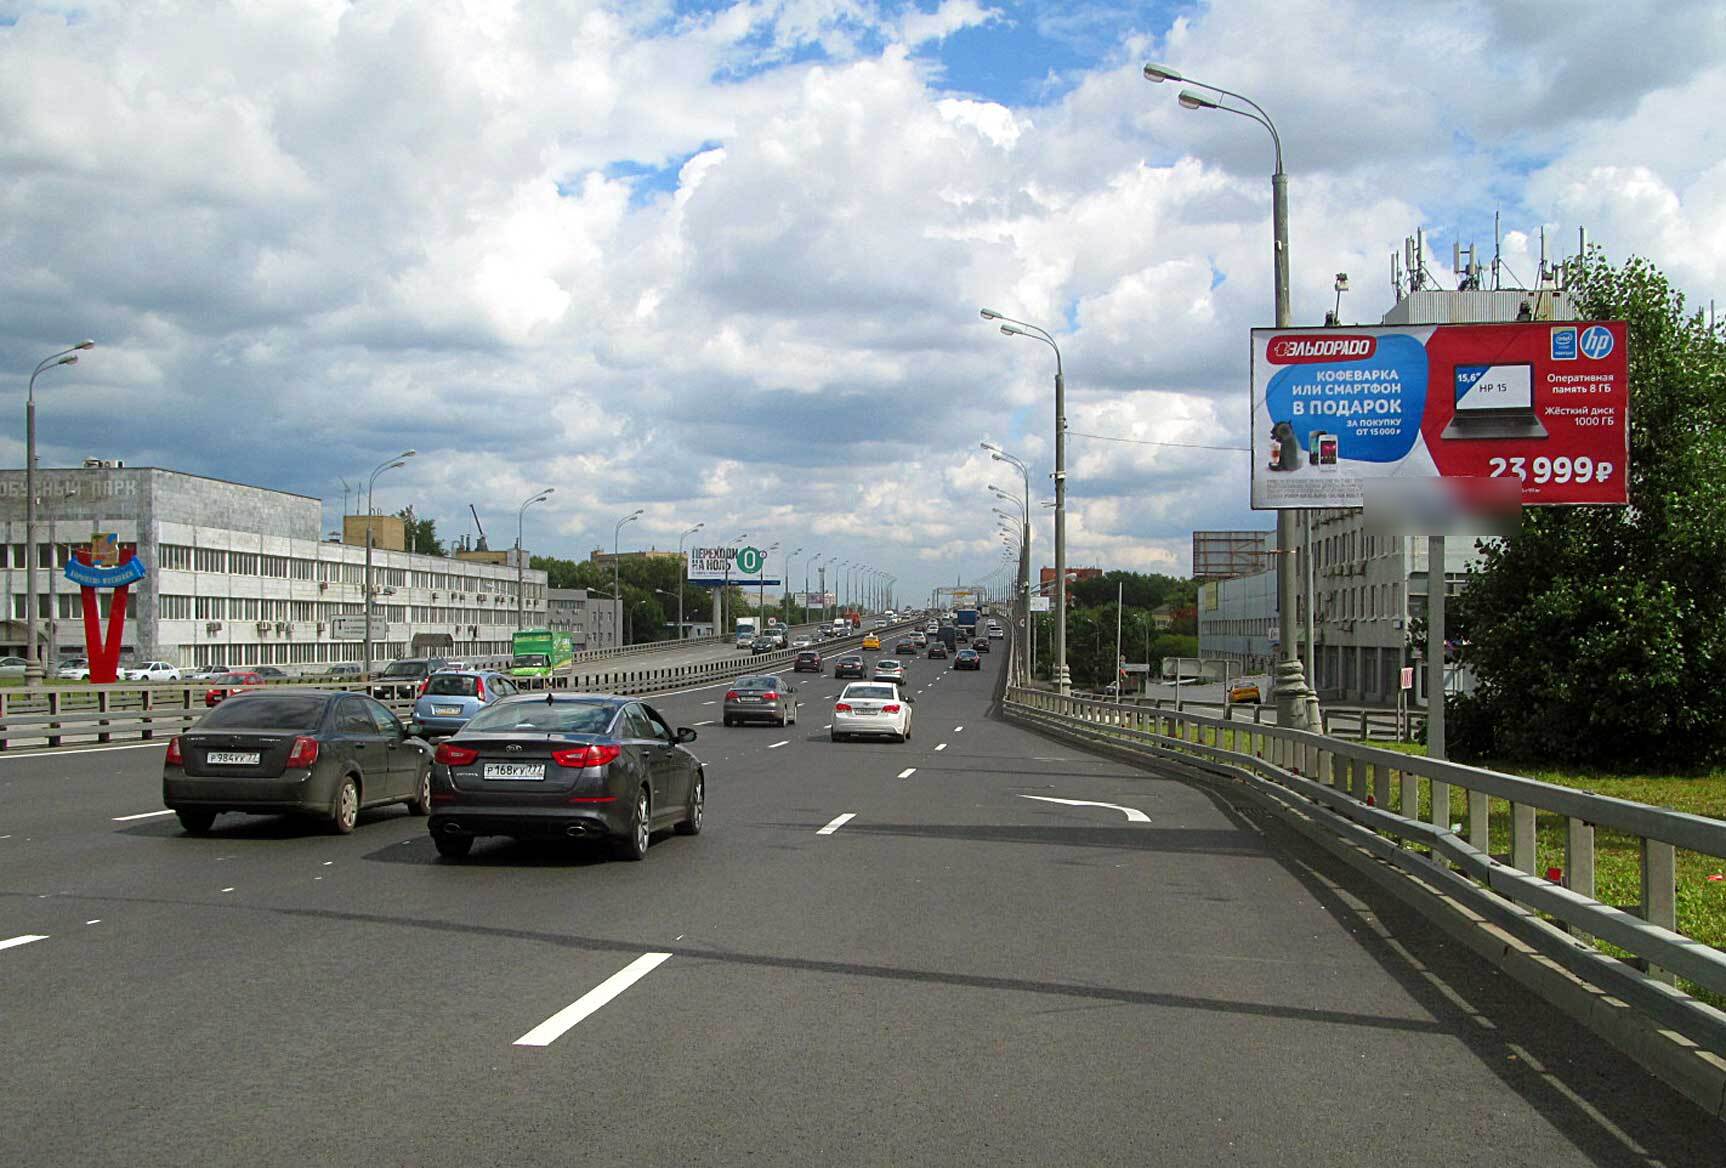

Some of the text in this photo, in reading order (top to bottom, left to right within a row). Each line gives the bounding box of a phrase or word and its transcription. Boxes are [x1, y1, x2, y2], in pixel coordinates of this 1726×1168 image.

[1584, 328, 1609, 358] hp
[1317, 369, 1399, 382] КОФЕВАРКА
[1547, 373, 1614, 384] Оперативная
[1292, 383, 1401, 396] ИЛИ СМАРТФОН
[1480, 384, 1507, 392] HP 15
[1552, 383, 1611, 394] память 8 ГБ
[1293, 399, 1402, 416] В ПОДАРОК
[1545, 406, 1615, 415] Жёсткий диск
[1347, 418, 1402, 428] ЗА ПОКУПКУ
[1575, 416, 1614, 426] 1000 ГБ
[1356, 428, 1368, 436] ОТ
[92, 479, 136, 496] ПАРК
[692, 547, 738, 560] ПЕРЕХОДИ
[706, 560, 731, 570] НОЛЬ
